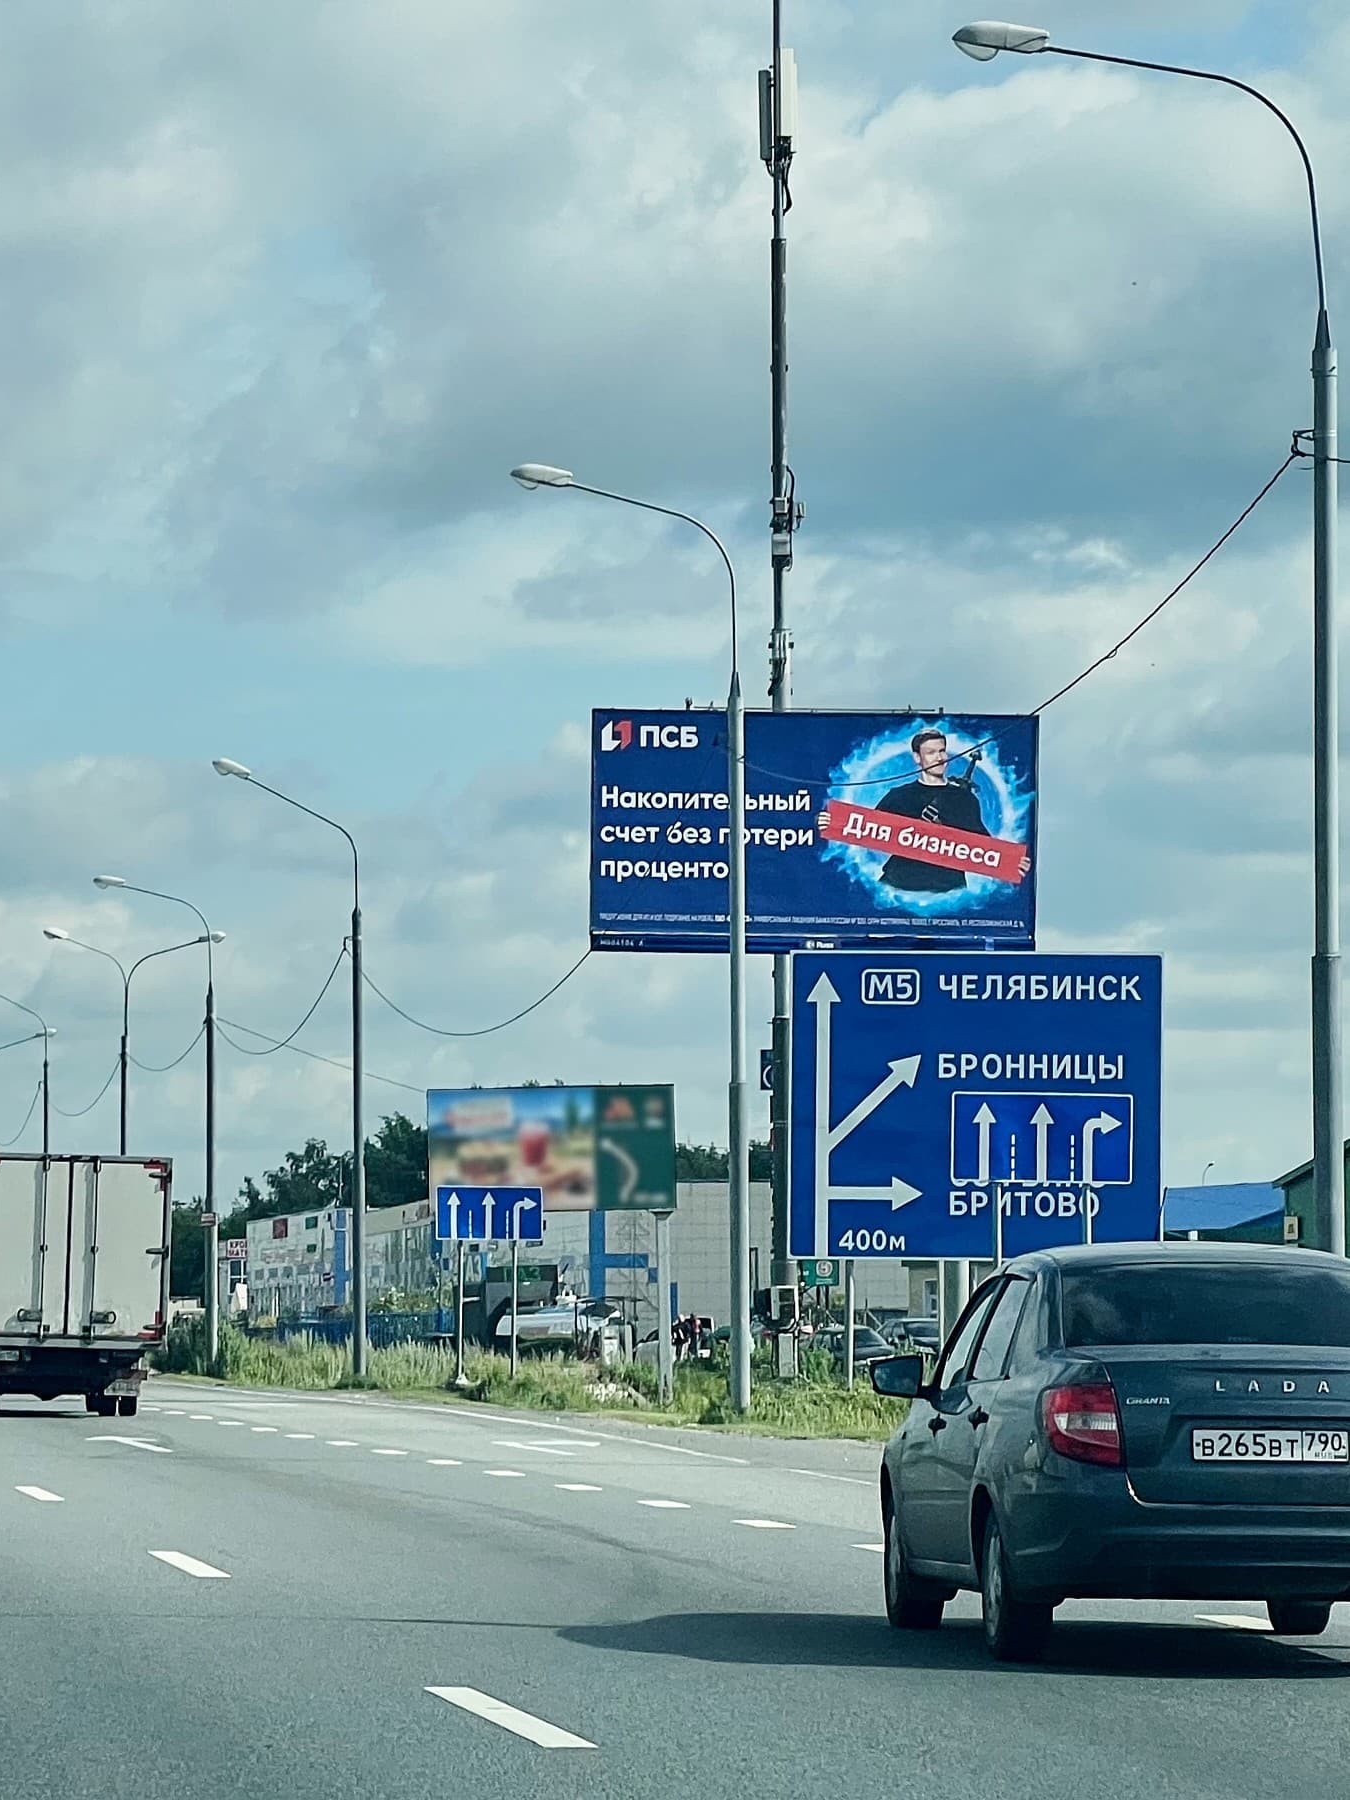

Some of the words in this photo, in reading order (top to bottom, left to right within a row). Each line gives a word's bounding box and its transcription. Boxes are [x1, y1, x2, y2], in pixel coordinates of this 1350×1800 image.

[640, 725, 699, 748] ПСБ
[601, 785, 811, 812] Накопитеьный
[600, 825, 660, 844] счет
[666, 821, 712, 845] без
[842, 813, 892, 843] Для
[897, 826, 1001, 868] бизнеса
[600, 859, 731, 883] проценто
[868, 976, 913, 1000] М5
[938, 974, 1142, 1002] ЧЕЛЯБИНСК
[937, 1053, 1125, 1085] БРОННИЦЫ
[949, 1191, 1100, 1217] БРИТОВО
[838, 1229, 906, 1252] 400м
[1214, 1379, 1331, 1394] LADA
[1125, 1397, 1171, 1406] GRANTA
[1304, 1432, 1342, 1452] 790
